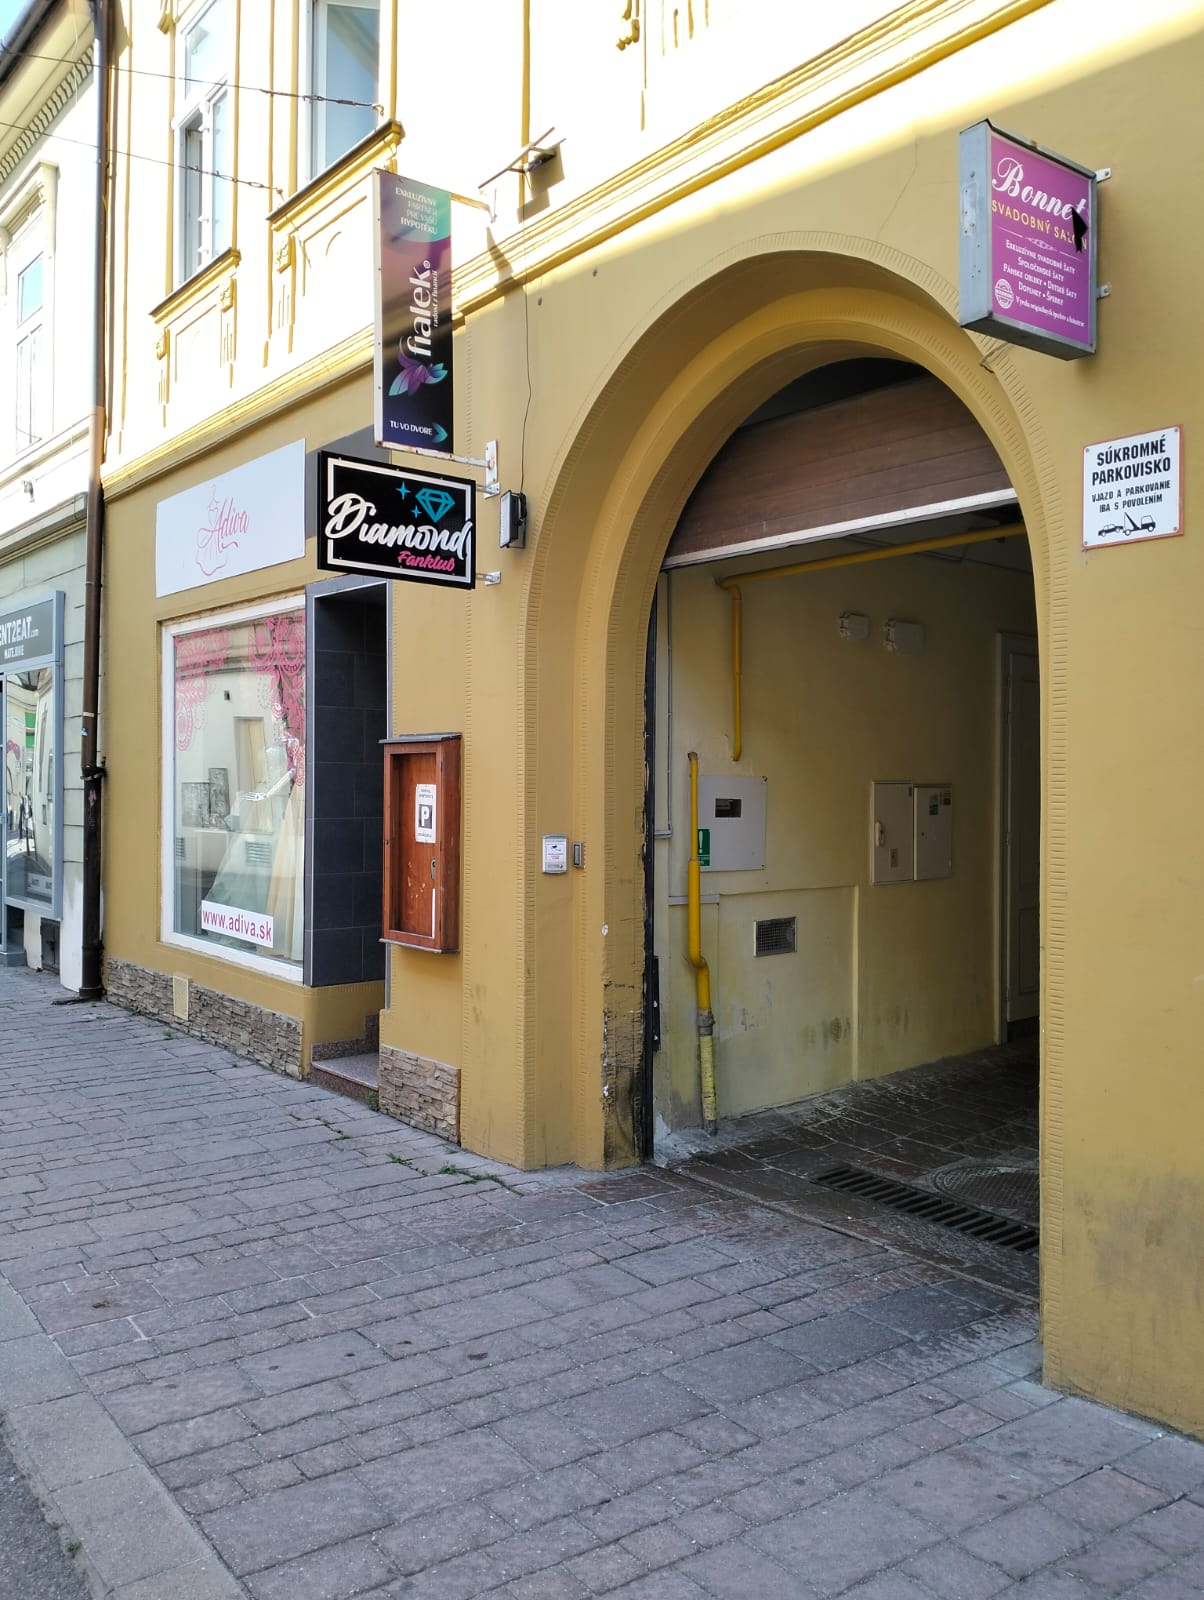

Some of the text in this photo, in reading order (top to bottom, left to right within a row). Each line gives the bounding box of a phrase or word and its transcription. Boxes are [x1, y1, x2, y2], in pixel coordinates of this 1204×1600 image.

[991, 199, 1051, 234] SVADOBNÝ
[406, 266, 432, 357] fialek
[390, 420, 433, 436] TU VO DVORE
[1097, 434, 1166, 467] SÚKROMNÉ
[1092, 456, 1171, 487] PARKOVISKO
[1091, 479, 1171, 503] VJAZD A PARKOVANIE
[1099, 493, 1163, 513] IBA S POVOLENÍM
[324, 492, 473, 561] Diamond
[397, 550, 456, 572] Fanklub
[202, 910, 272, 942] www.adiva.sk
